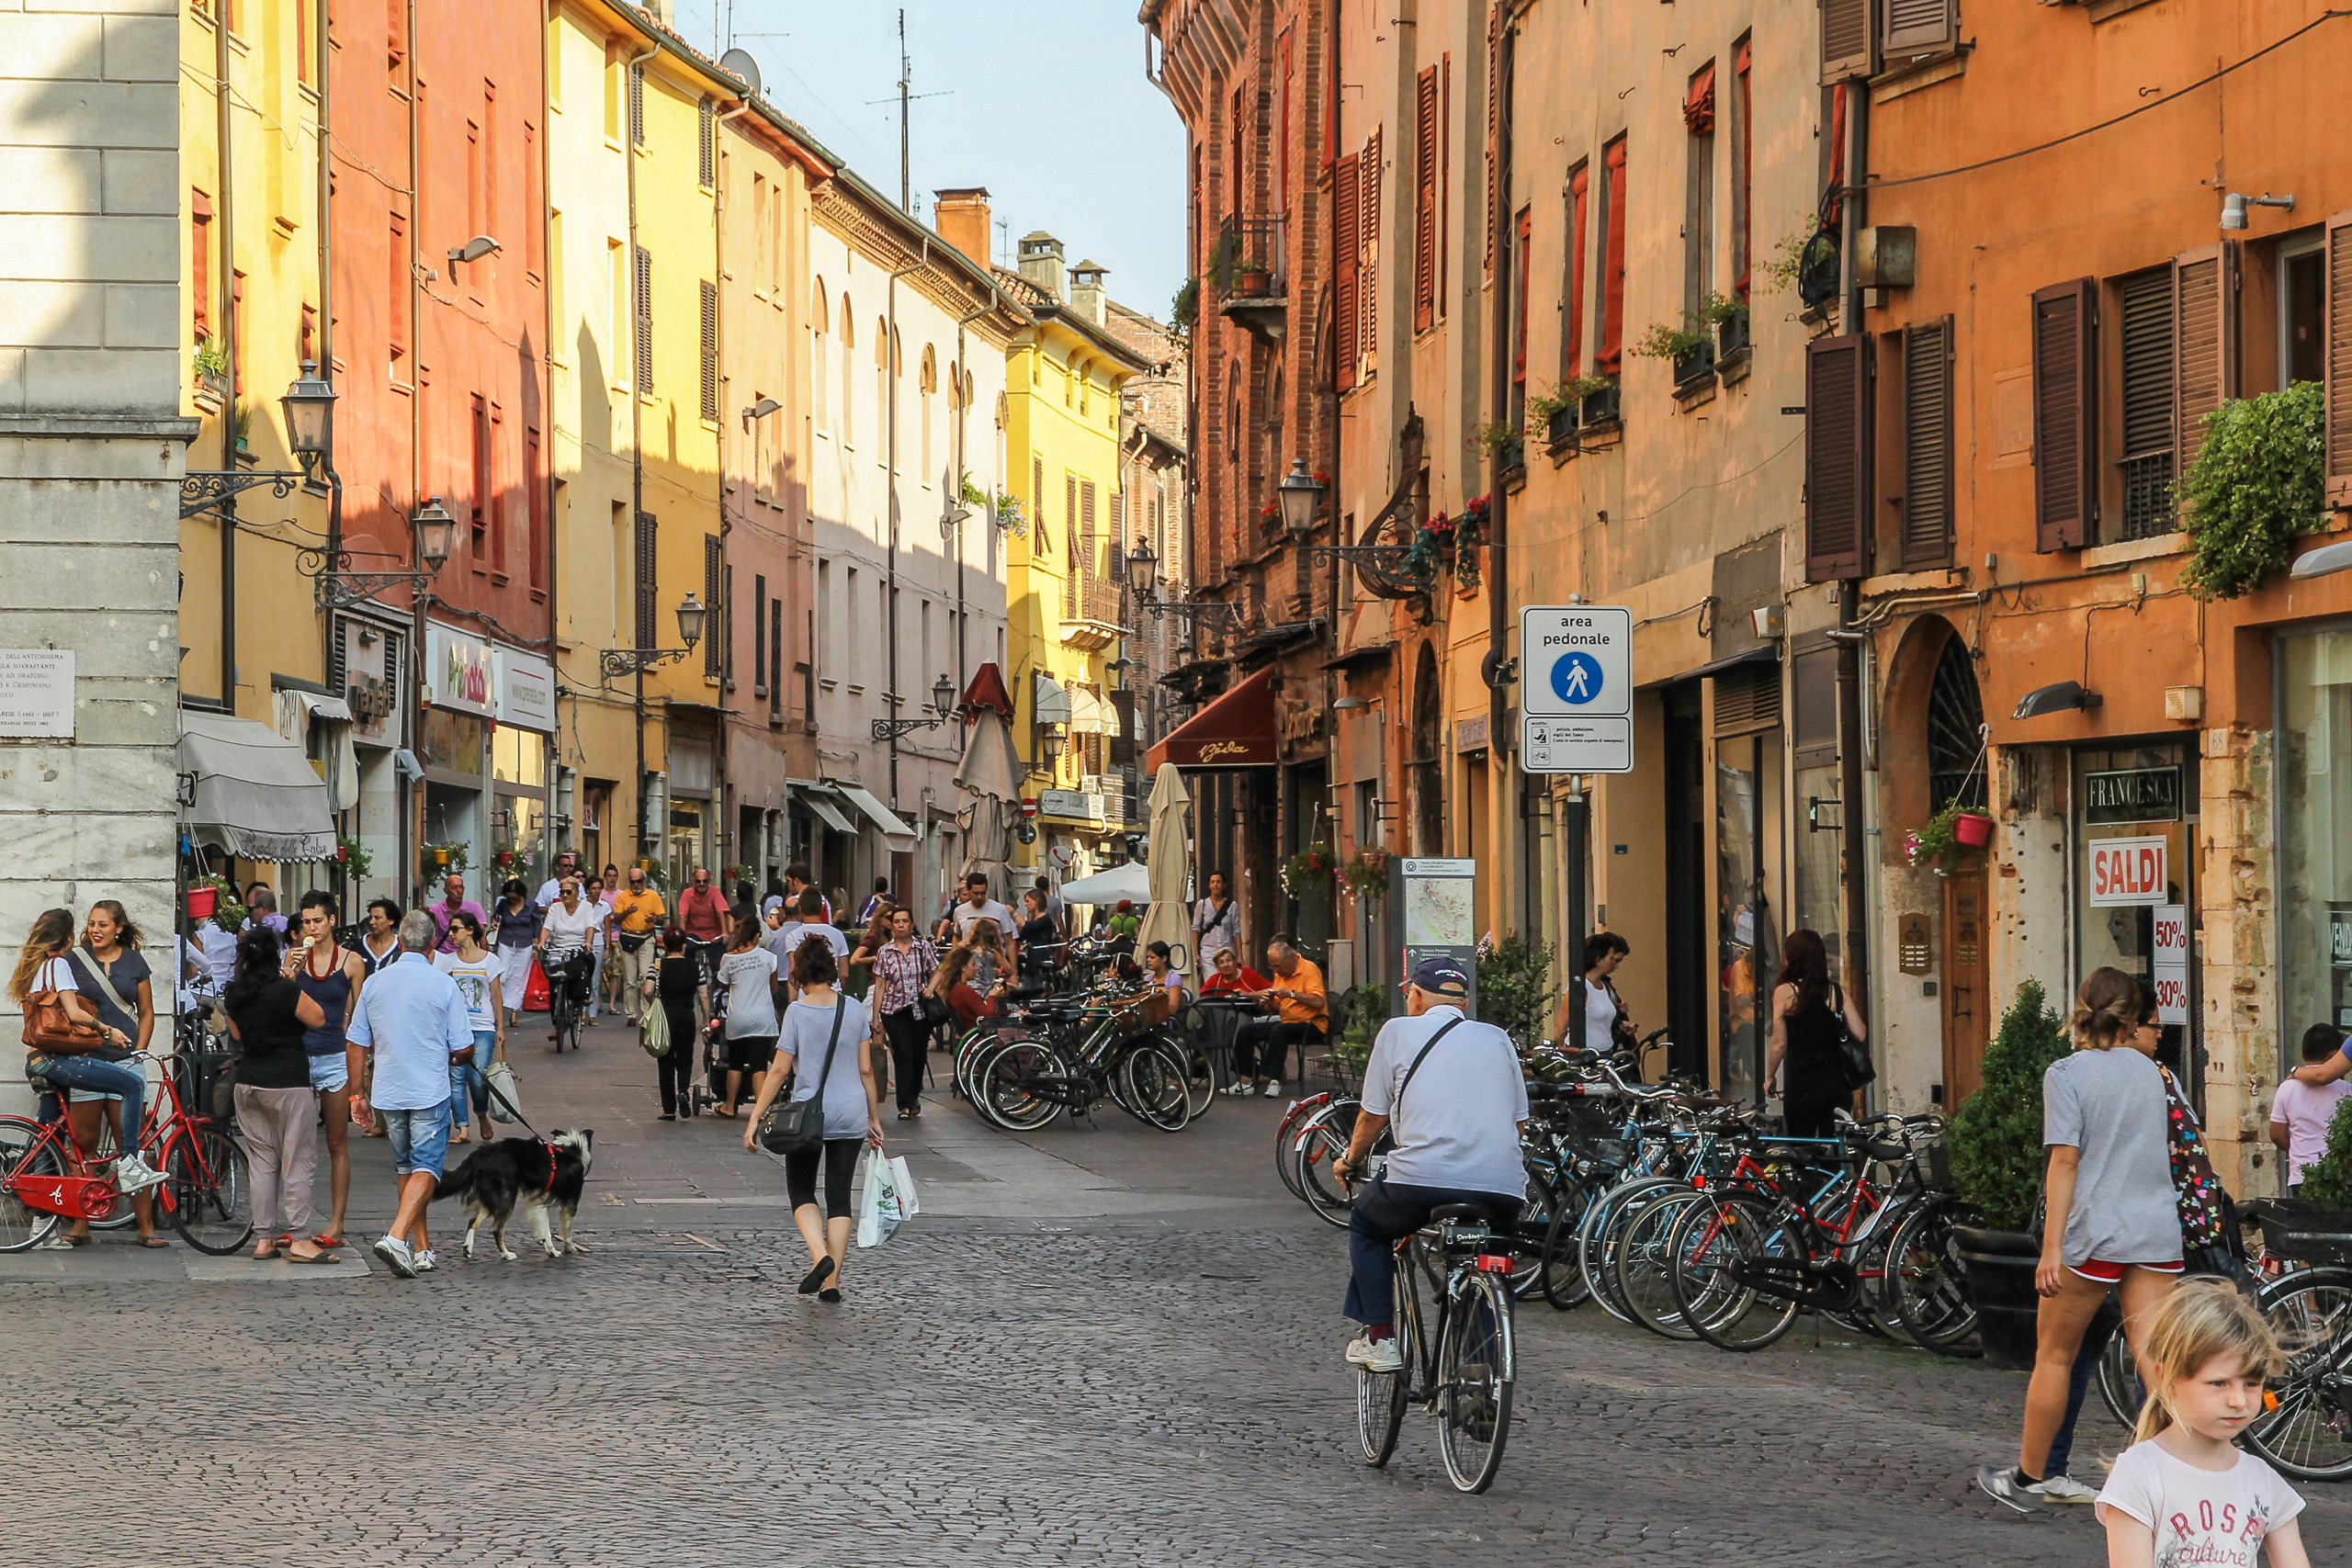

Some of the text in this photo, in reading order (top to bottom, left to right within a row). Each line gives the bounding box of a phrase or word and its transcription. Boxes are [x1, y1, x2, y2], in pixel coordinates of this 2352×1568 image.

[1560, 617, 1592, 627] area
[1544, 632, 1611, 647] pedonale
[2089, 774, 2173, 807] FRANCESCA
[2095, 847, 2164, 896] SALDI
[2155, 920, 2187, 948] 50%
[2156, 980, 2187, 1009] 30%
[2178, 1536, 2249, 1567] culture
